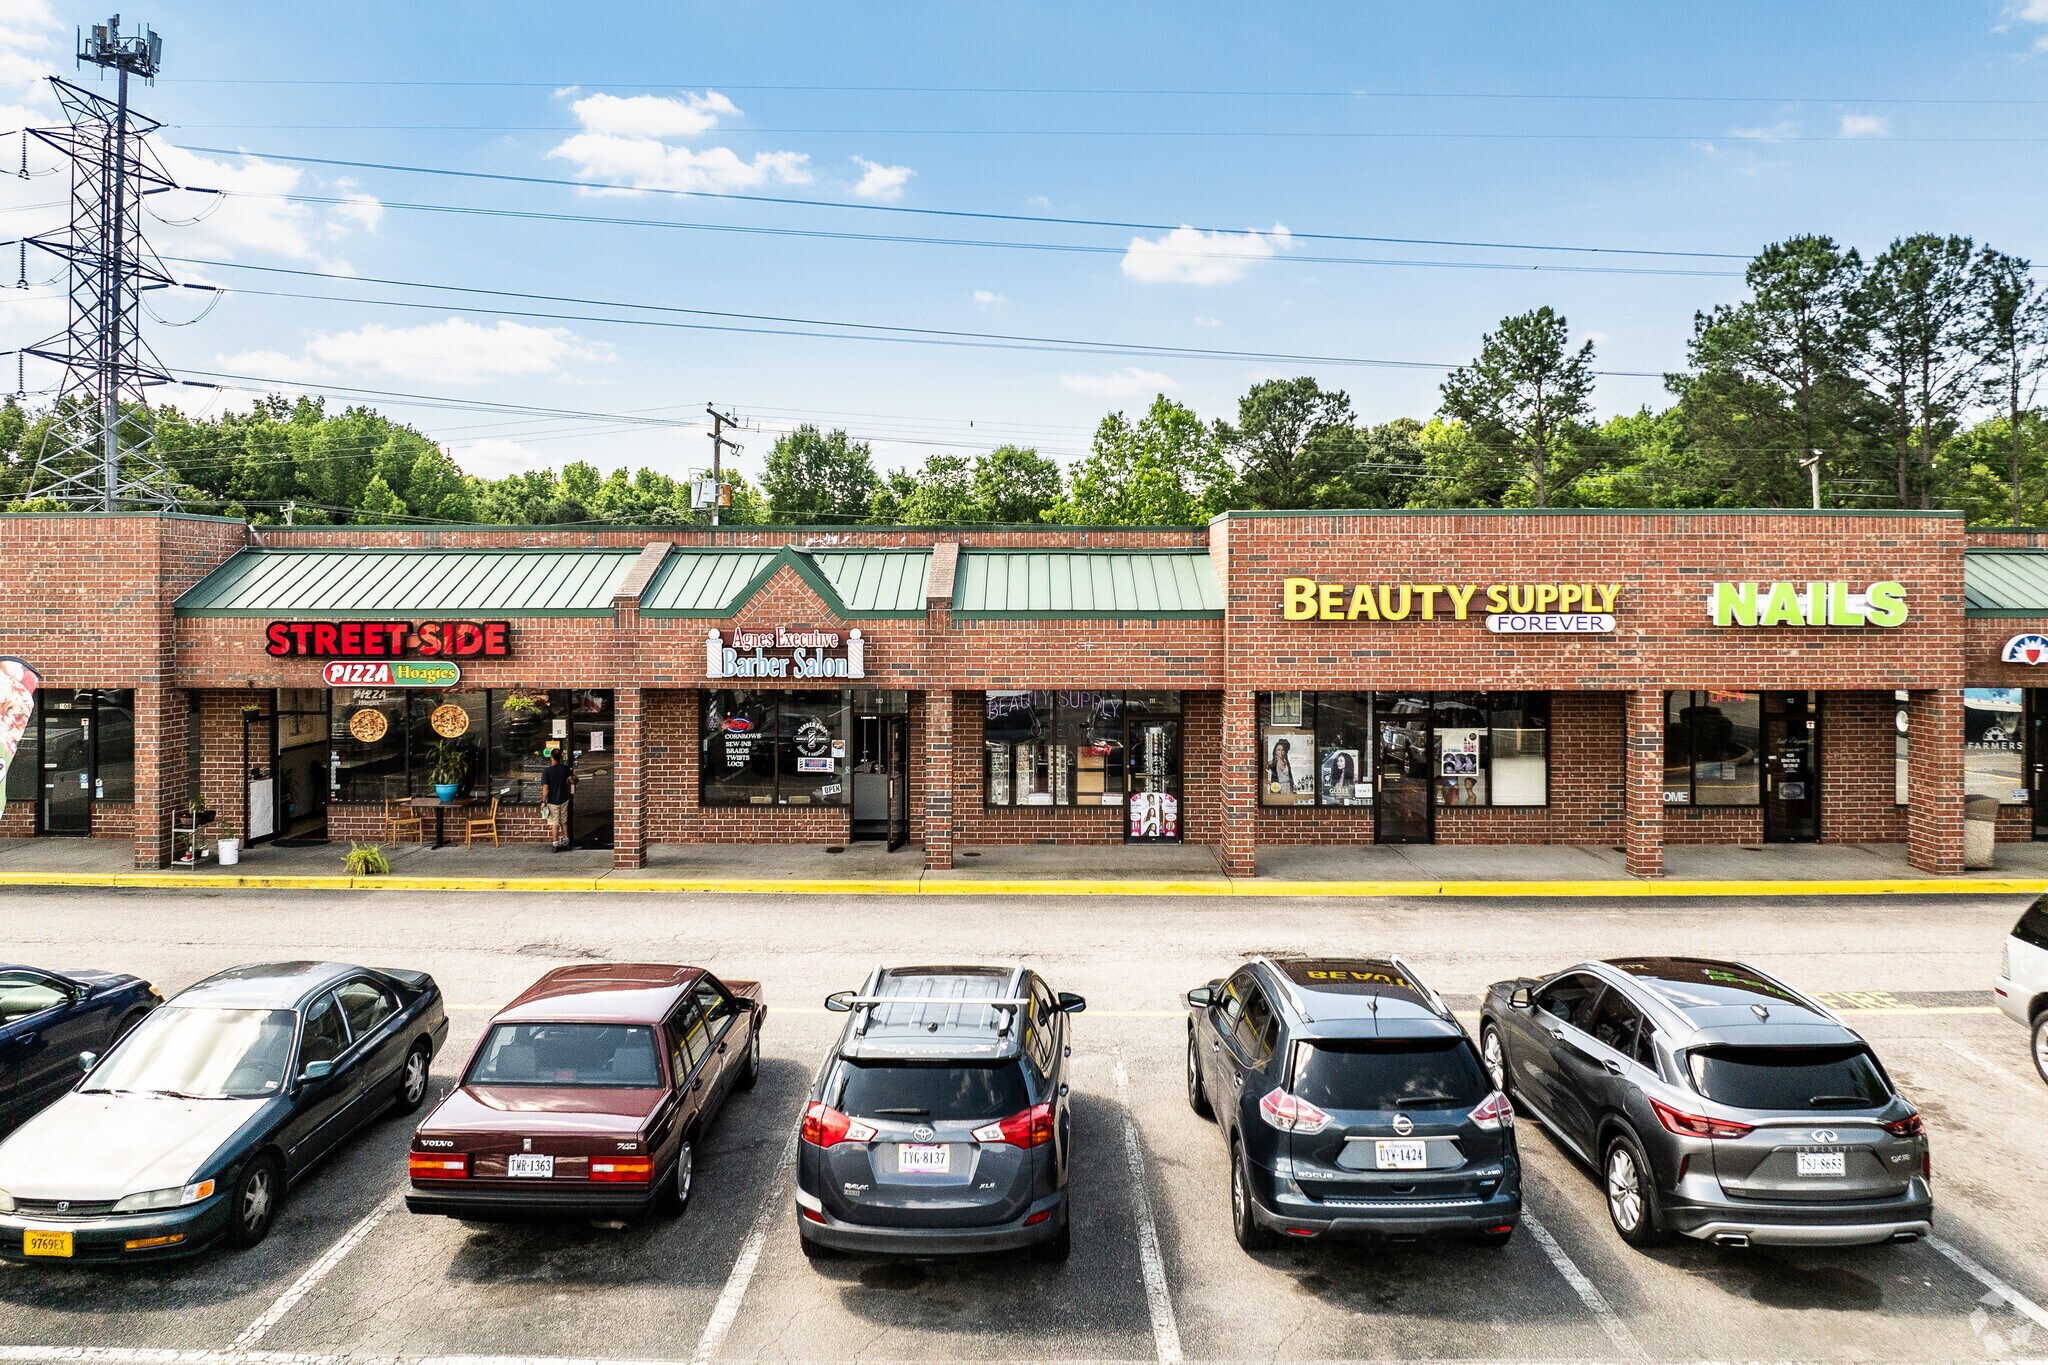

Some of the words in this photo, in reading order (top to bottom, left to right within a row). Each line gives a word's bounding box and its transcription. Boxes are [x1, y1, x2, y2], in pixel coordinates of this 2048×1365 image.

[1283, 577, 1477, 621] BEAUTY
[1485, 583, 1622, 614] SUPPLY
[1713, 581, 1908, 627] NAILS
[1497, 615, 1606, 632] FOREVER
[267, 622, 409, 657] STREET
[418, 622, 507, 657] SIDE
[733, 626, 774, 651] Agnes
[775, 626, 839, 648] Executive
[722, 647, 789, 678] Barber
[793, 647, 848, 678] Salon
[329, 663, 389, 683] PIZZA
[396, 665, 456, 683] Hoagies
[1058, 690, 1120, 719] SUPPLY
[1967, 741, 2023, 750] FARMERS
[824, 785, 841, 794] OPEN
[617, 1142, 637, 1150] 740
[1297, 1171, 1334, 1179] ROGUE
[31, 1238, 65, 1250] 9769EX
